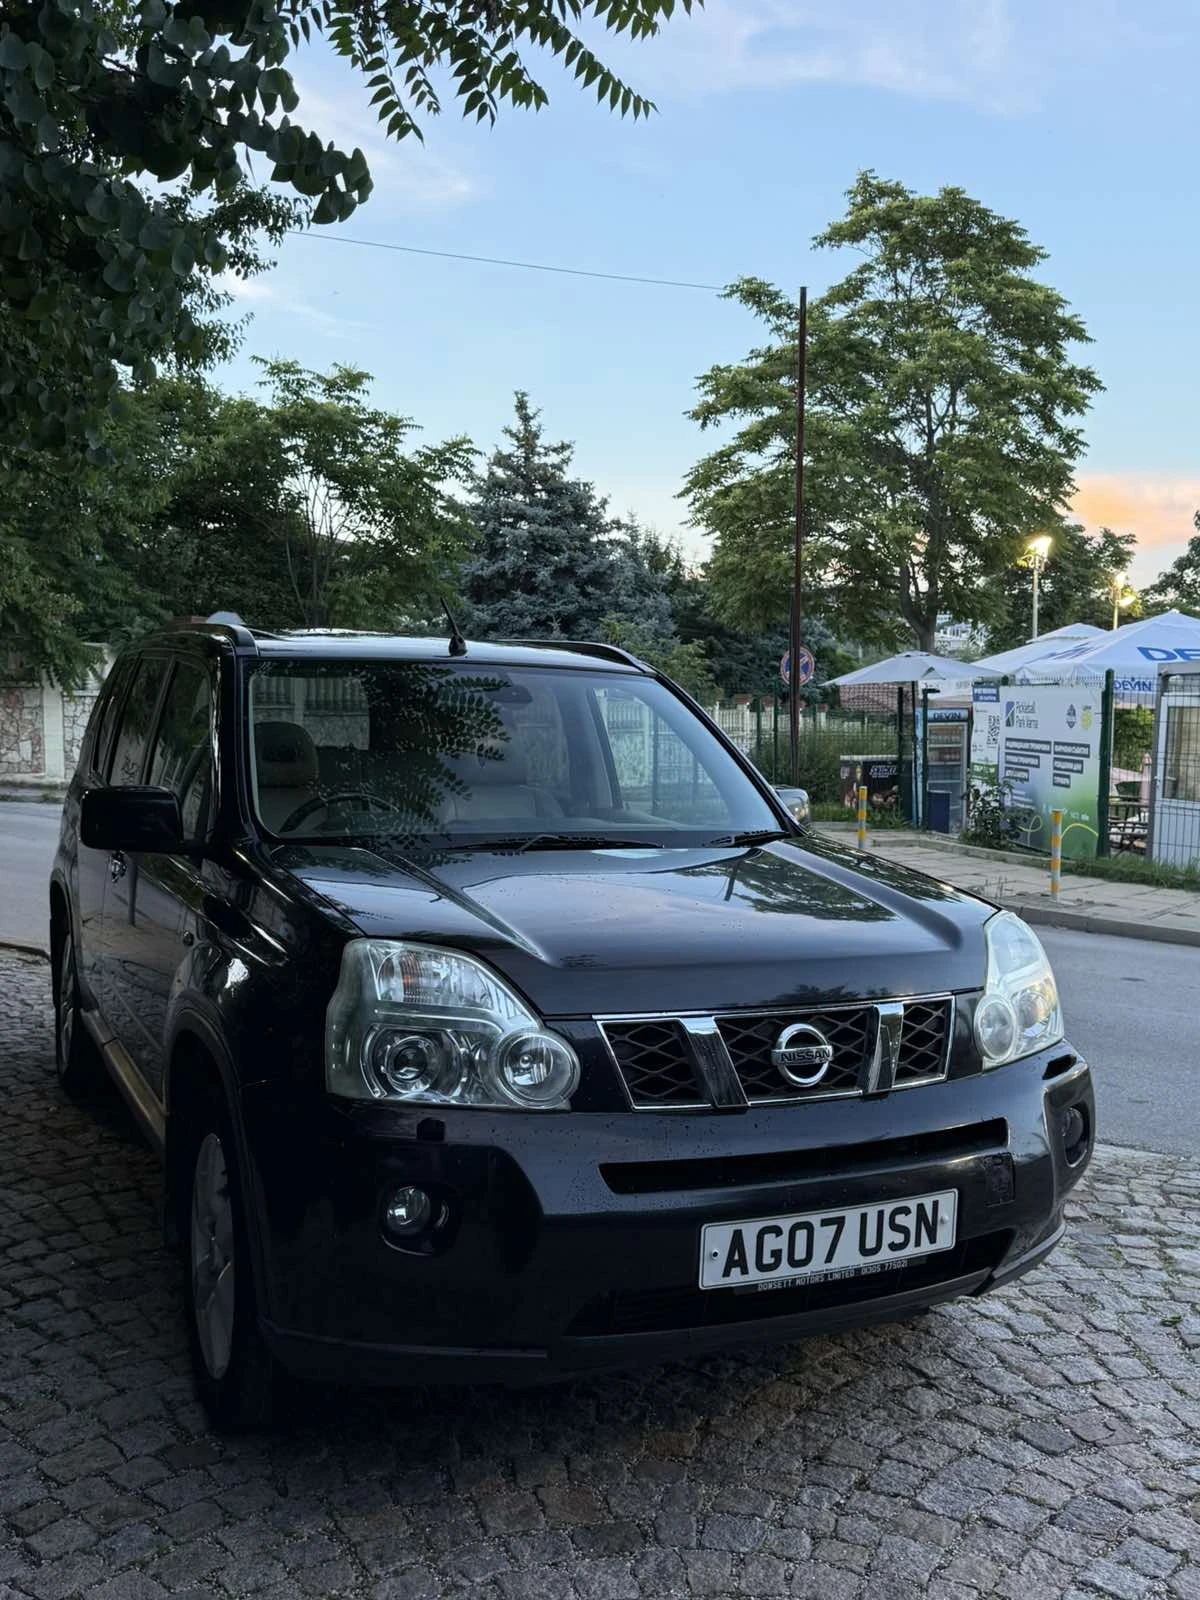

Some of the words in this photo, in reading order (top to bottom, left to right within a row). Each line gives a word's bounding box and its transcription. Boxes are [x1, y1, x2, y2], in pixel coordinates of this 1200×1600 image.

[1113, 679, 1152, 691] DEVIN
[933, 711, 961, 721] DEVIN
[781, 1049, 830, 1062] NISSAN
[722, 1216, 846, 1278] AG07
[858, 1199, 939, 1258] USN
[796, 1274, 825, 1286] MOTORS
[827, 1269, 855, 1281] LIMITED
